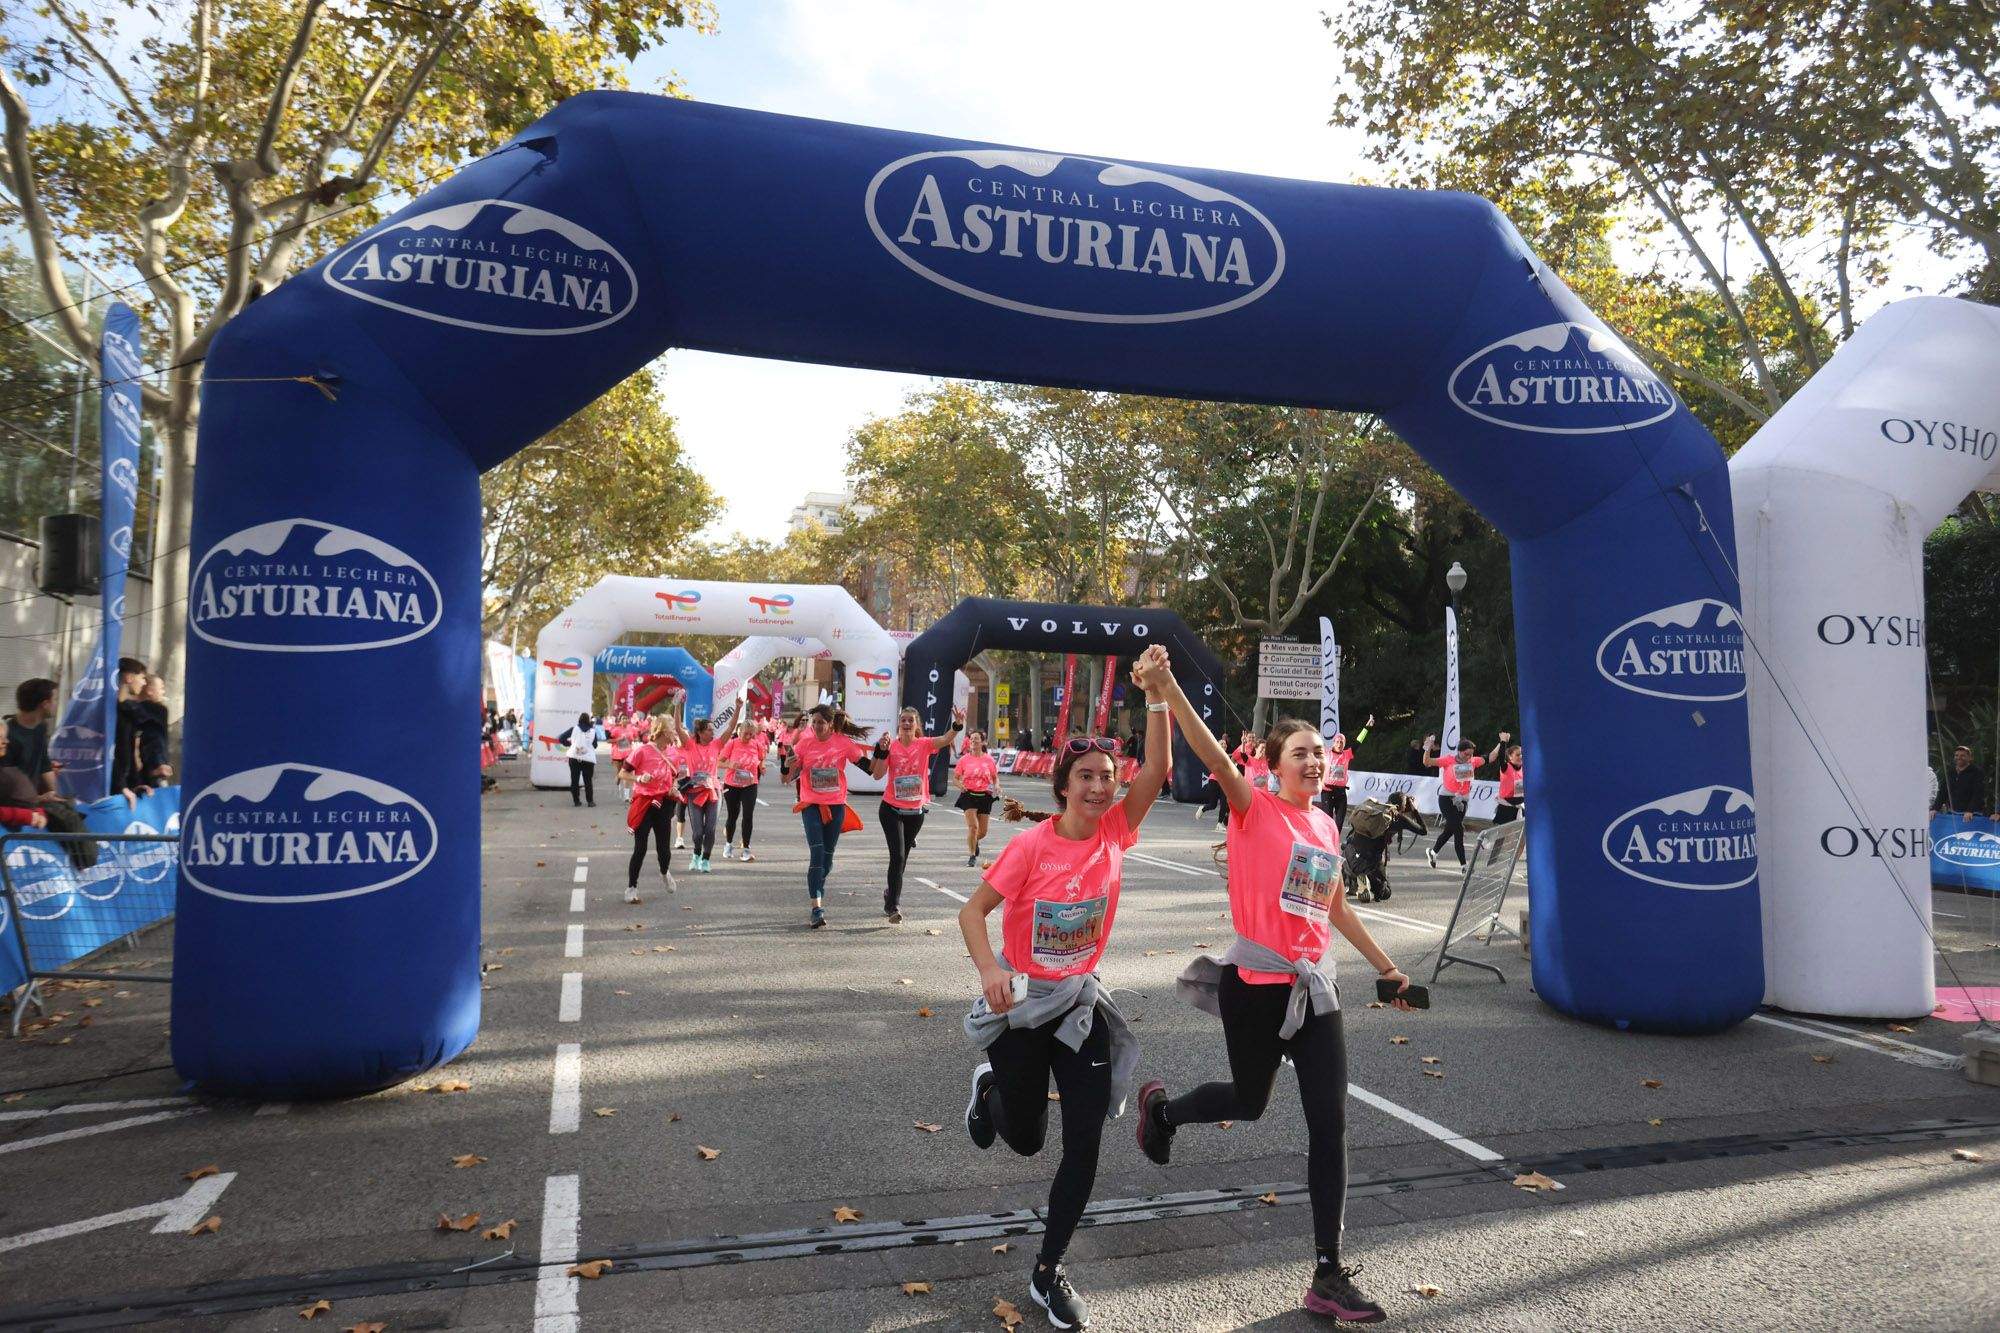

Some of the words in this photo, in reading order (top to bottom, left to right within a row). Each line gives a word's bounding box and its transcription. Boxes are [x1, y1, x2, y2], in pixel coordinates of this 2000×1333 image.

[967, 177, 1100, 209] CENTRAL
[1113, 196, 1242, 228] LECHERA
[897, 173, 1255, 286] ASTURIANA
[399, 237, 500, 254] CENTRAL
[510, 243, 611, 273] LECHERA
[339, 243, 614, 315] ASTURIANA
[1513, 358, 1592, 372] CENTRAL
[1467, 363, 1670, 406] ASTURIANA
[1880, 418, 1998, 461] OYSHO
[224, 564, 313, 579] CENTRAL
[322, 565, 419, 586] LECHERA
[195, 565, 425, 625] ASTURIANA
[654, 613, 702, 623] TotalEnergies
[748, 617, 794, 626] TotalEnergies
[1006, 616, 1149, 638] VOLVO
[1817, 614, 1925, 647] OYSH
[1651, 633, 1718, 645] CENTRAL
[1613, 638, 1744, 676] ASTURIA
[1269, 666, 1290, 674] Ciutat
[1292, 667, 1302, 675] del
[1304, 668, 1322, 676] Teatr
[1269, 680, 1294, 688] Institut
[1364, 777, 1413, 794] OYSHO
[213, 810, 302, 824] CENTRAL
[312, 810, 413, 824] LECHERA
[1657, 821, 1727, 833] CENTRAL
[186, 814, 420, 868] ASTURIANA
[1620, 825, 1758, 864] ASTURIAN
[1819, 825, 1927, 859] OYSH
[1938, 840, 2000, 860] ASTURIAN
